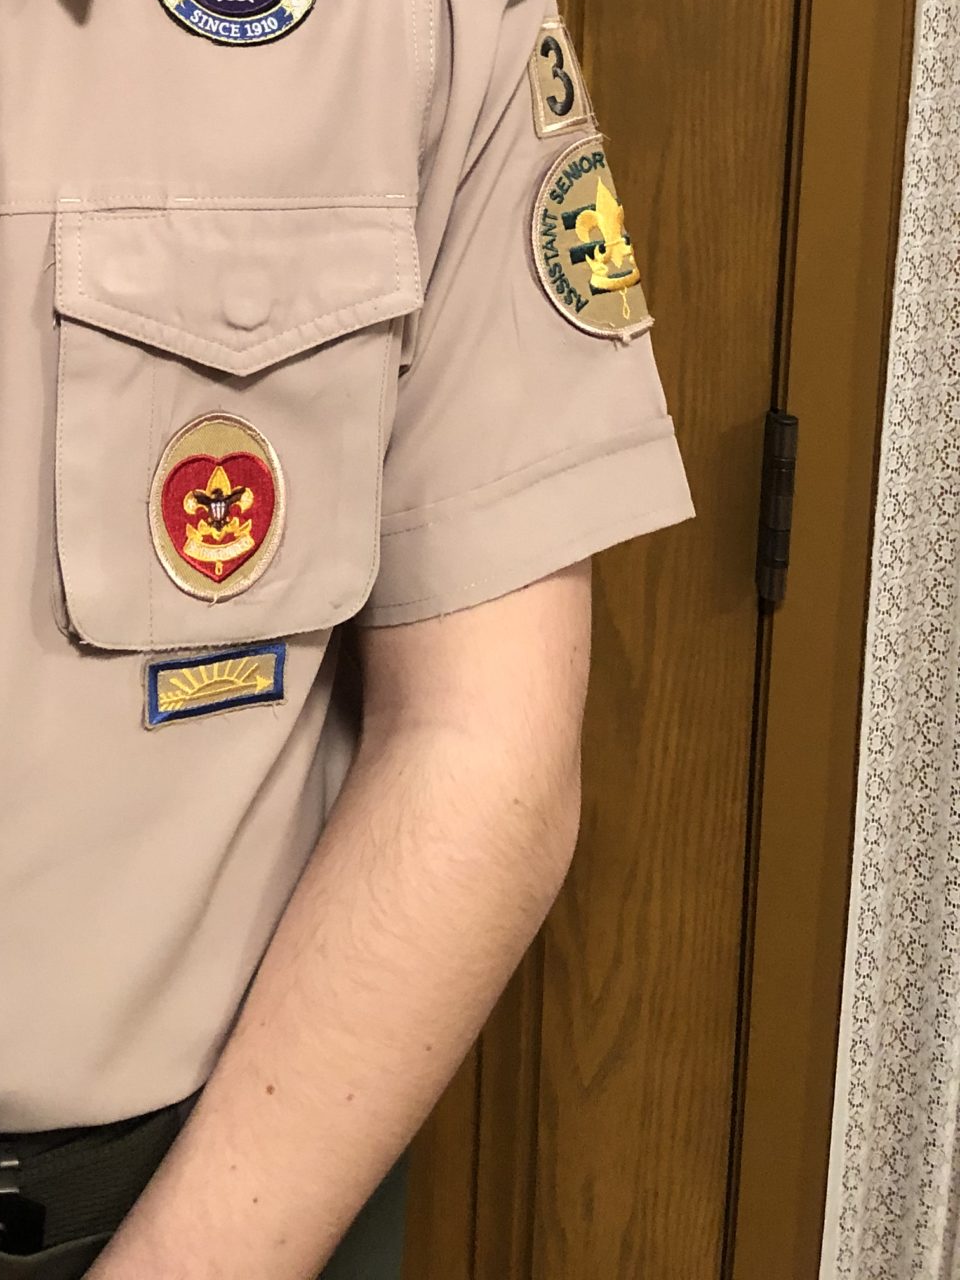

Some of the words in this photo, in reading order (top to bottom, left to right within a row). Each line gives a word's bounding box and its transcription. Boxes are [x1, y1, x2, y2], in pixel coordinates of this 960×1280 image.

[189, 9, 241, 38] SINCE
[244, 16, 279, 37] 1910
[540, 35, 575, 117] 3
[549, 150, 606, 205] SENIOR
[538, 209, 590, 315] ASSISTANT
